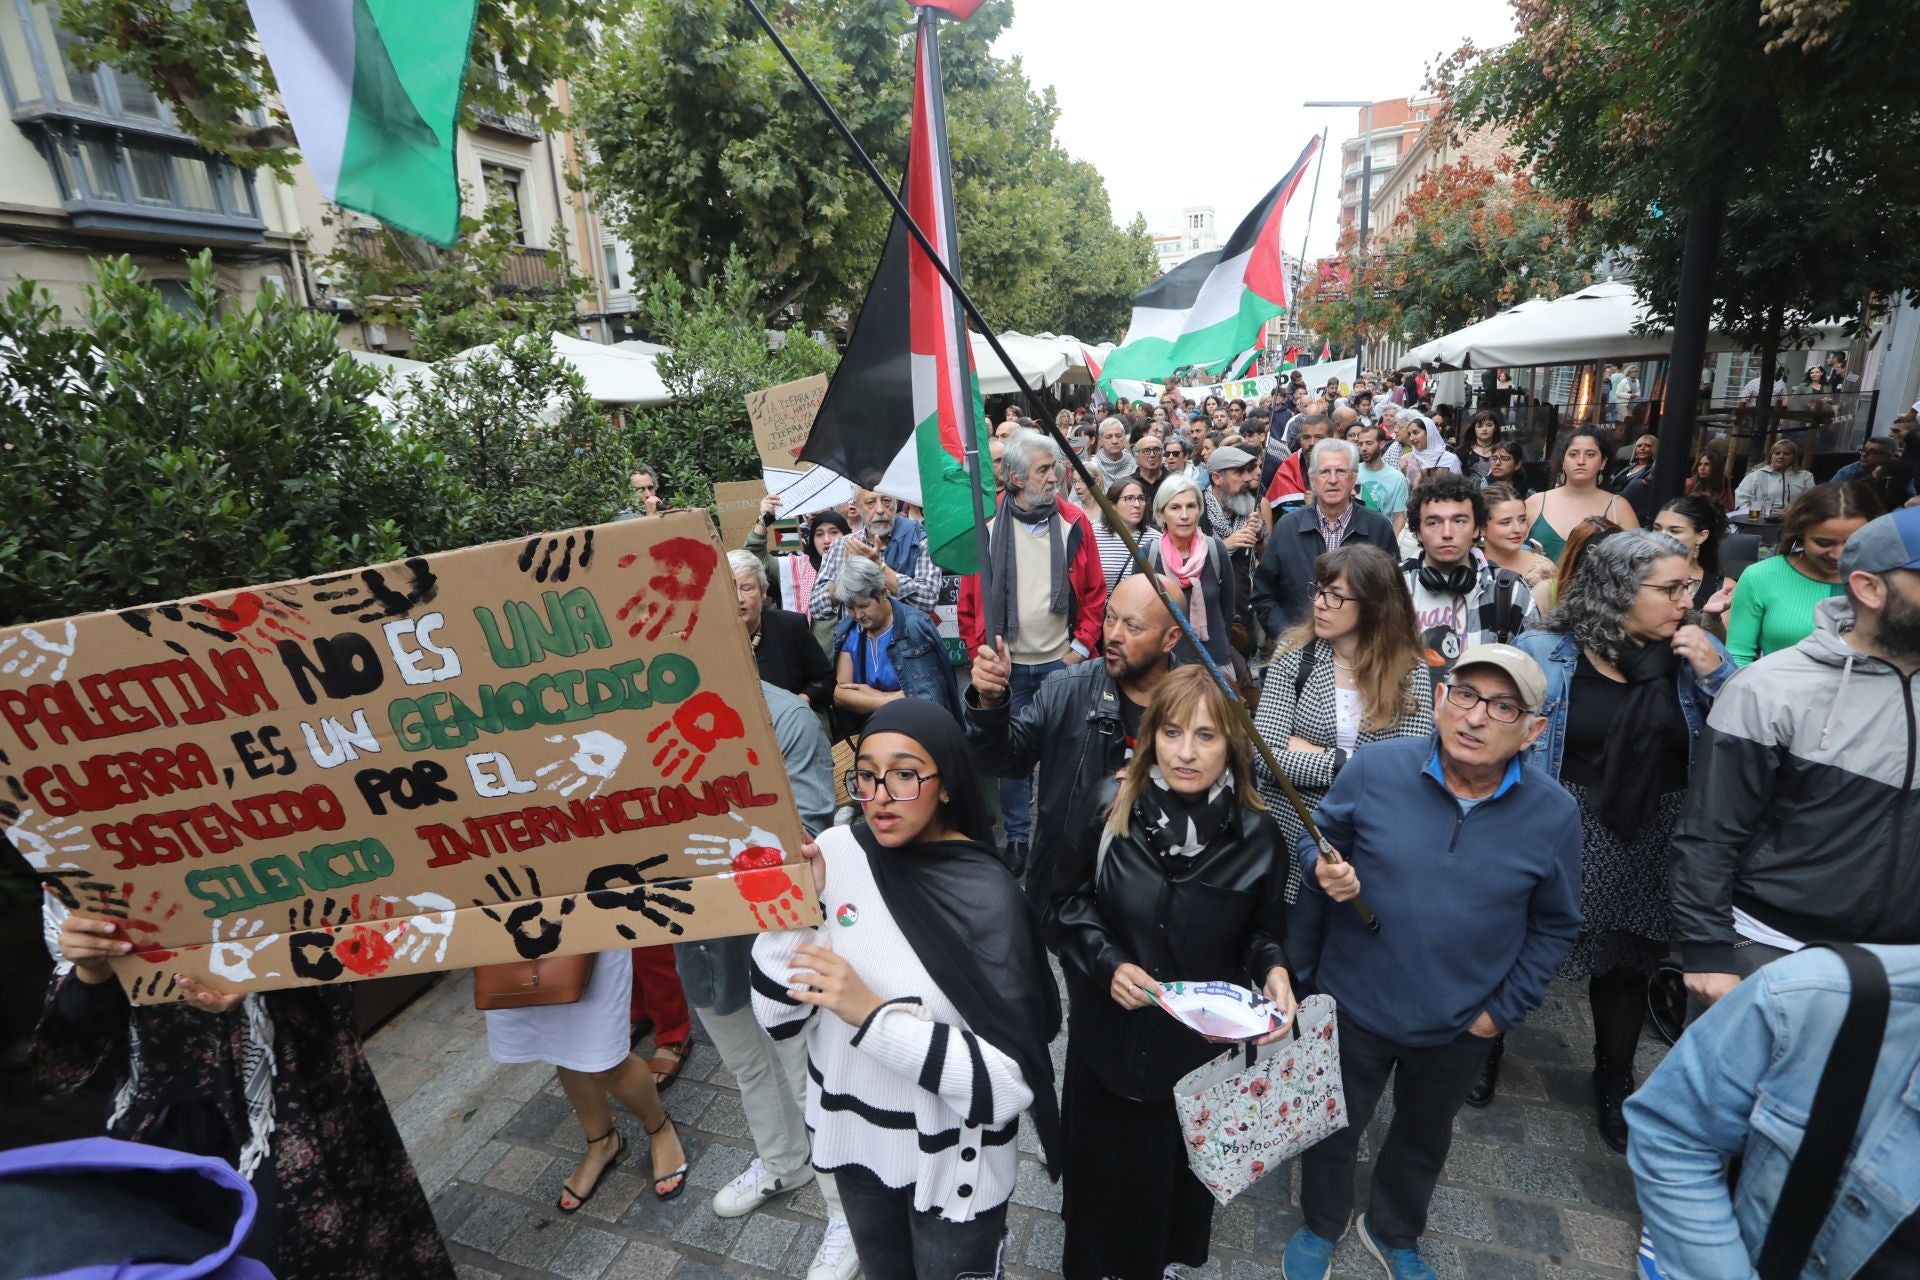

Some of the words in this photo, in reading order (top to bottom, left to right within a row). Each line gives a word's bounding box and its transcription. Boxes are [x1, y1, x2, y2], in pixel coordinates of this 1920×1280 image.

[769, 424, 804, 441] TIERRA
[778, 392, 810, 409] TIERRA
[0, 648, 279, 750] PALESTINA
[276, 632, 384, 705] NO
[382, 612, 462, 685] ES
[474, 586, 613, 669] UNA
[300, 708, 382, 769] UN
[387, 653, 701, 752] GENOCIDIO
[91, 783, 346, 870] SOSTENIDO
[354, 760, 458, 816] POR
[465, 752, 538, 798] EL
[185, 837, 395, 918] SILENCIO
[415, 771, 778, 869] INTERNACIONAL
